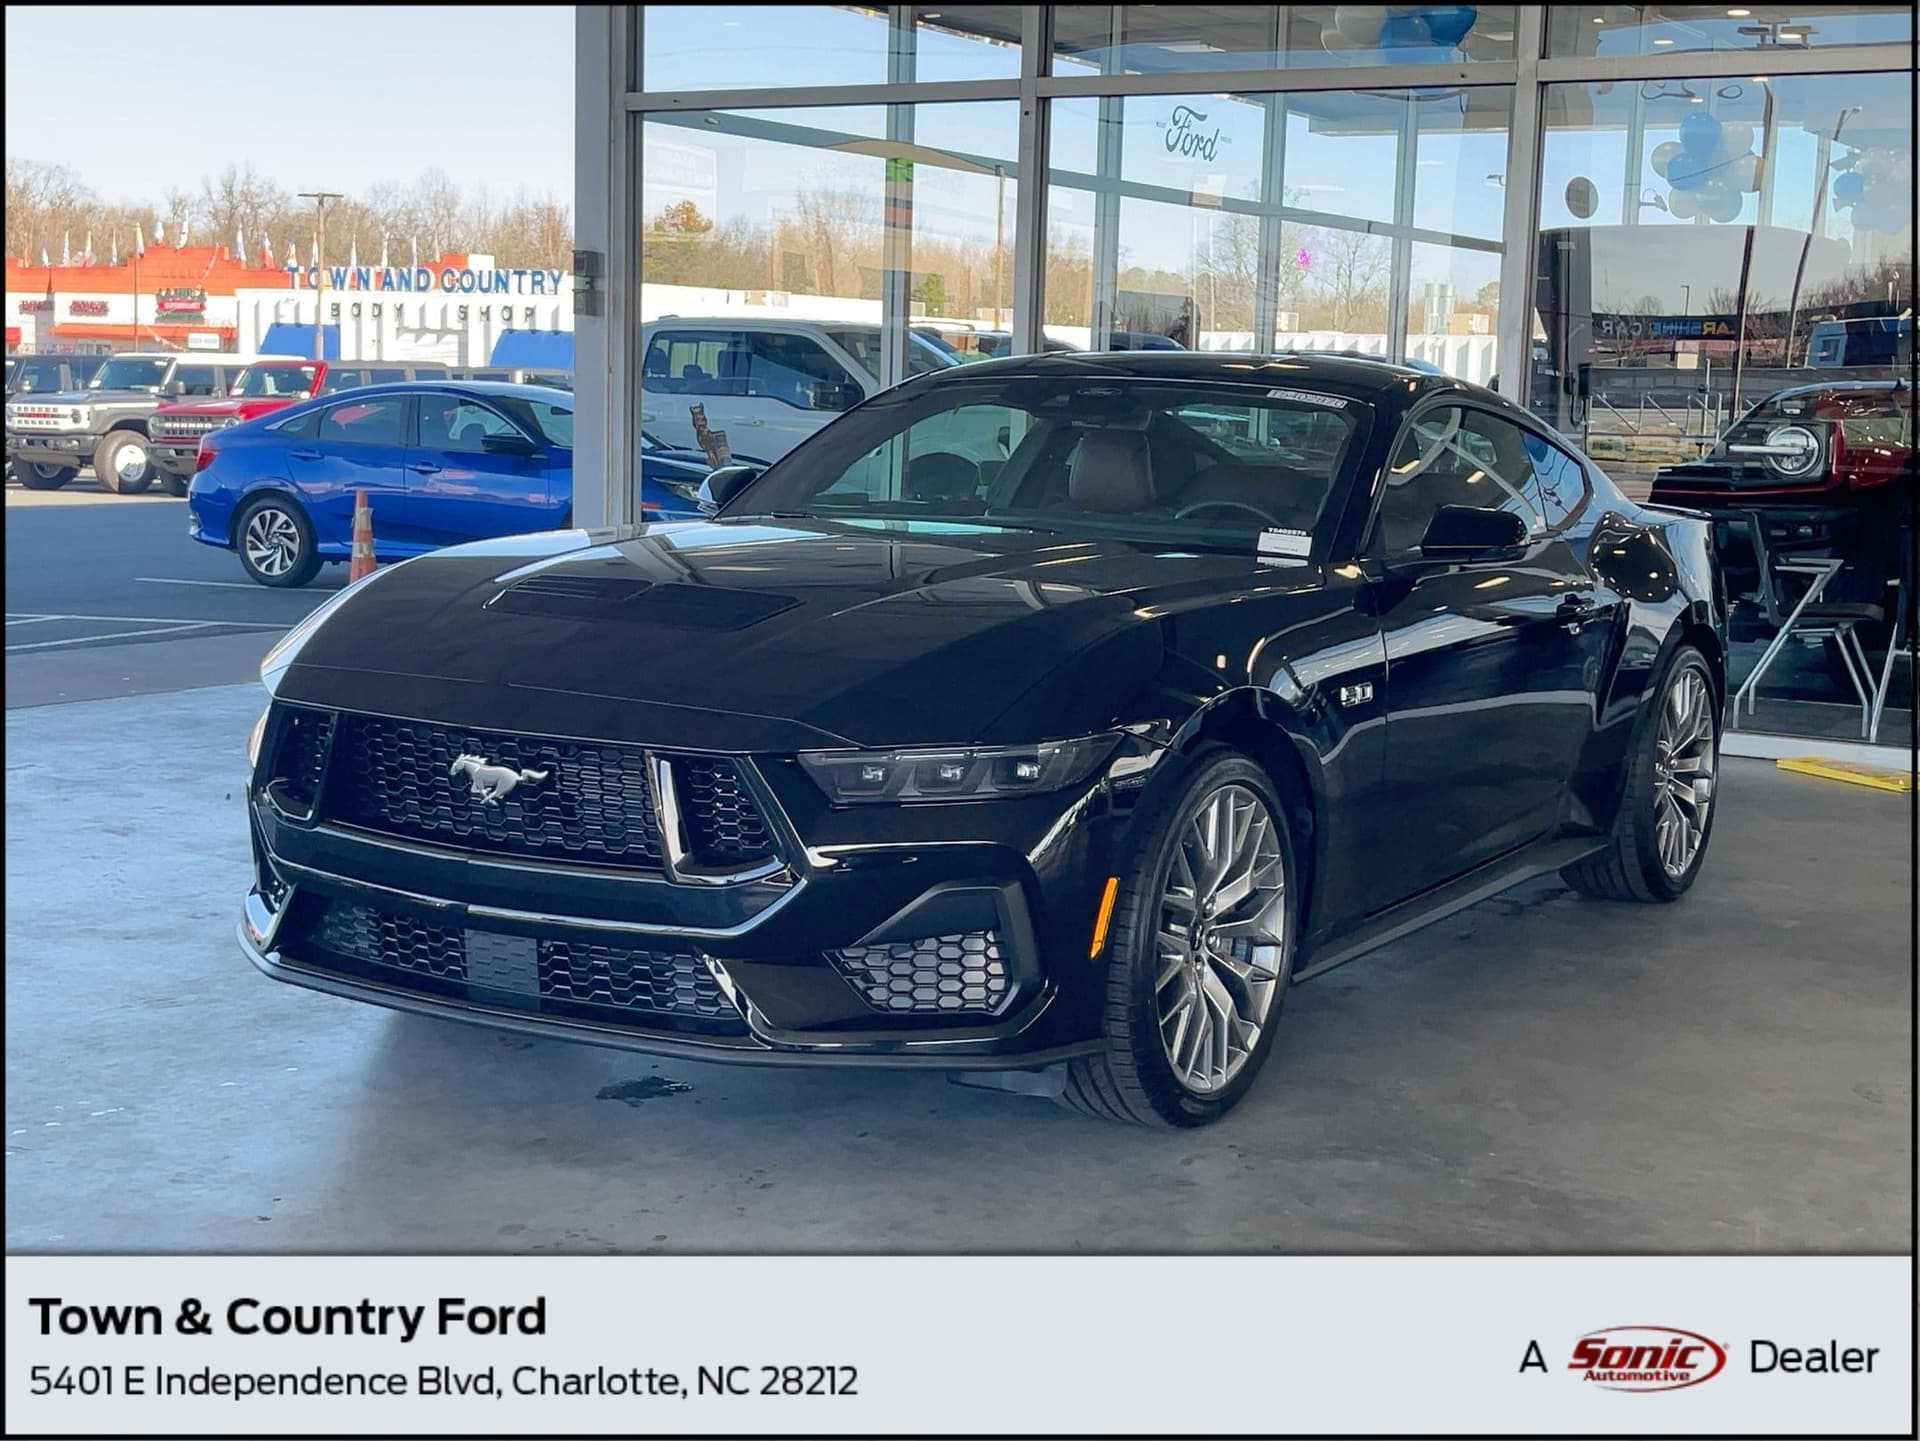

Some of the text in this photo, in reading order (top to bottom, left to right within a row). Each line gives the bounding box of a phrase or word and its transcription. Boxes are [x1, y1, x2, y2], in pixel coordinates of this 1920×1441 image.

[1166, 105, 1220, 161] Ford
[288, 266, 562, 294] TOWN AND COUNTRY
[330, 302, 537, 322] BODY SHOP
